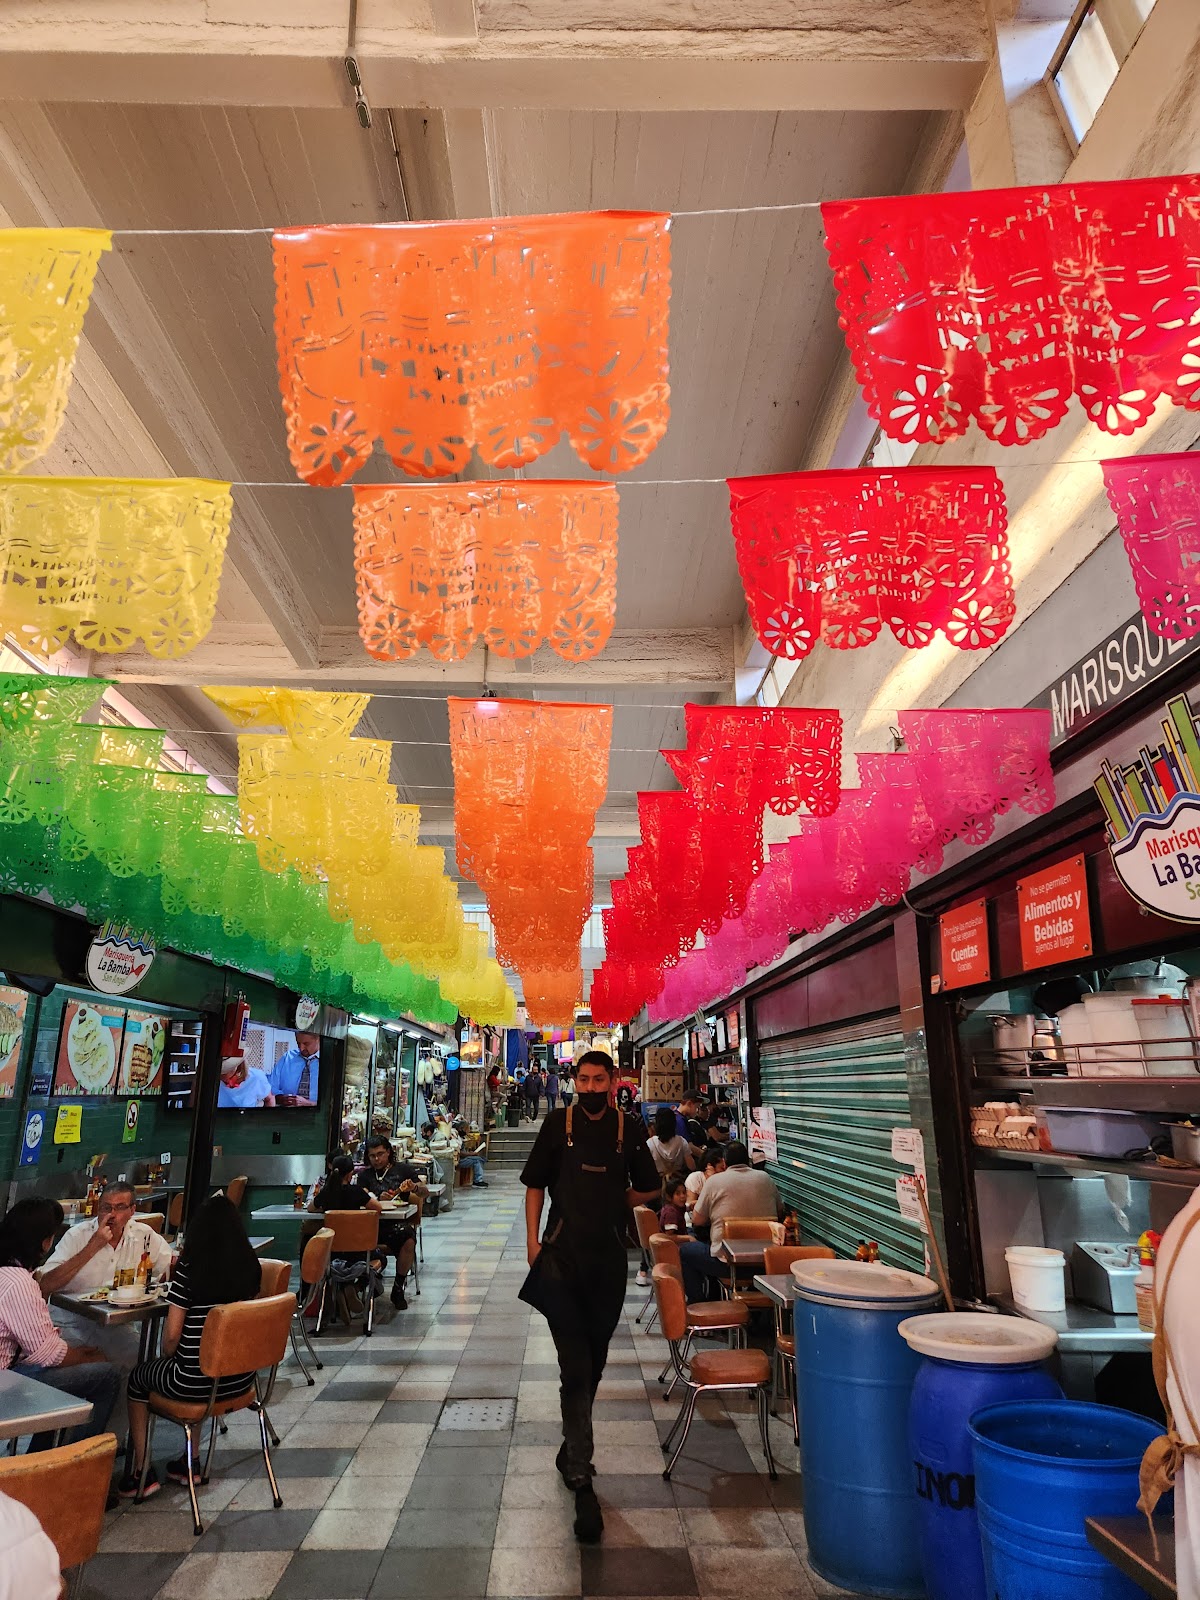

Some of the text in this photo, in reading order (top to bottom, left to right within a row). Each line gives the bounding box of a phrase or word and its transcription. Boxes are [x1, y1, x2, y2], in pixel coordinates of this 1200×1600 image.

[1051, 600, 1200, 737] MARISQUE
[1030, 874, 1072, 897] No se permiten
[1151, 863, 1178, 887] La
[1024, 889, 1081, 922] Alimentos y
[1034, 916, 1074, 942] Bebidas
[951, 944, 978, 962] Cuentas
[1035, 935, 1075, 955] ajenos al lugar
[97, 957, 131, 976] La Bamba
